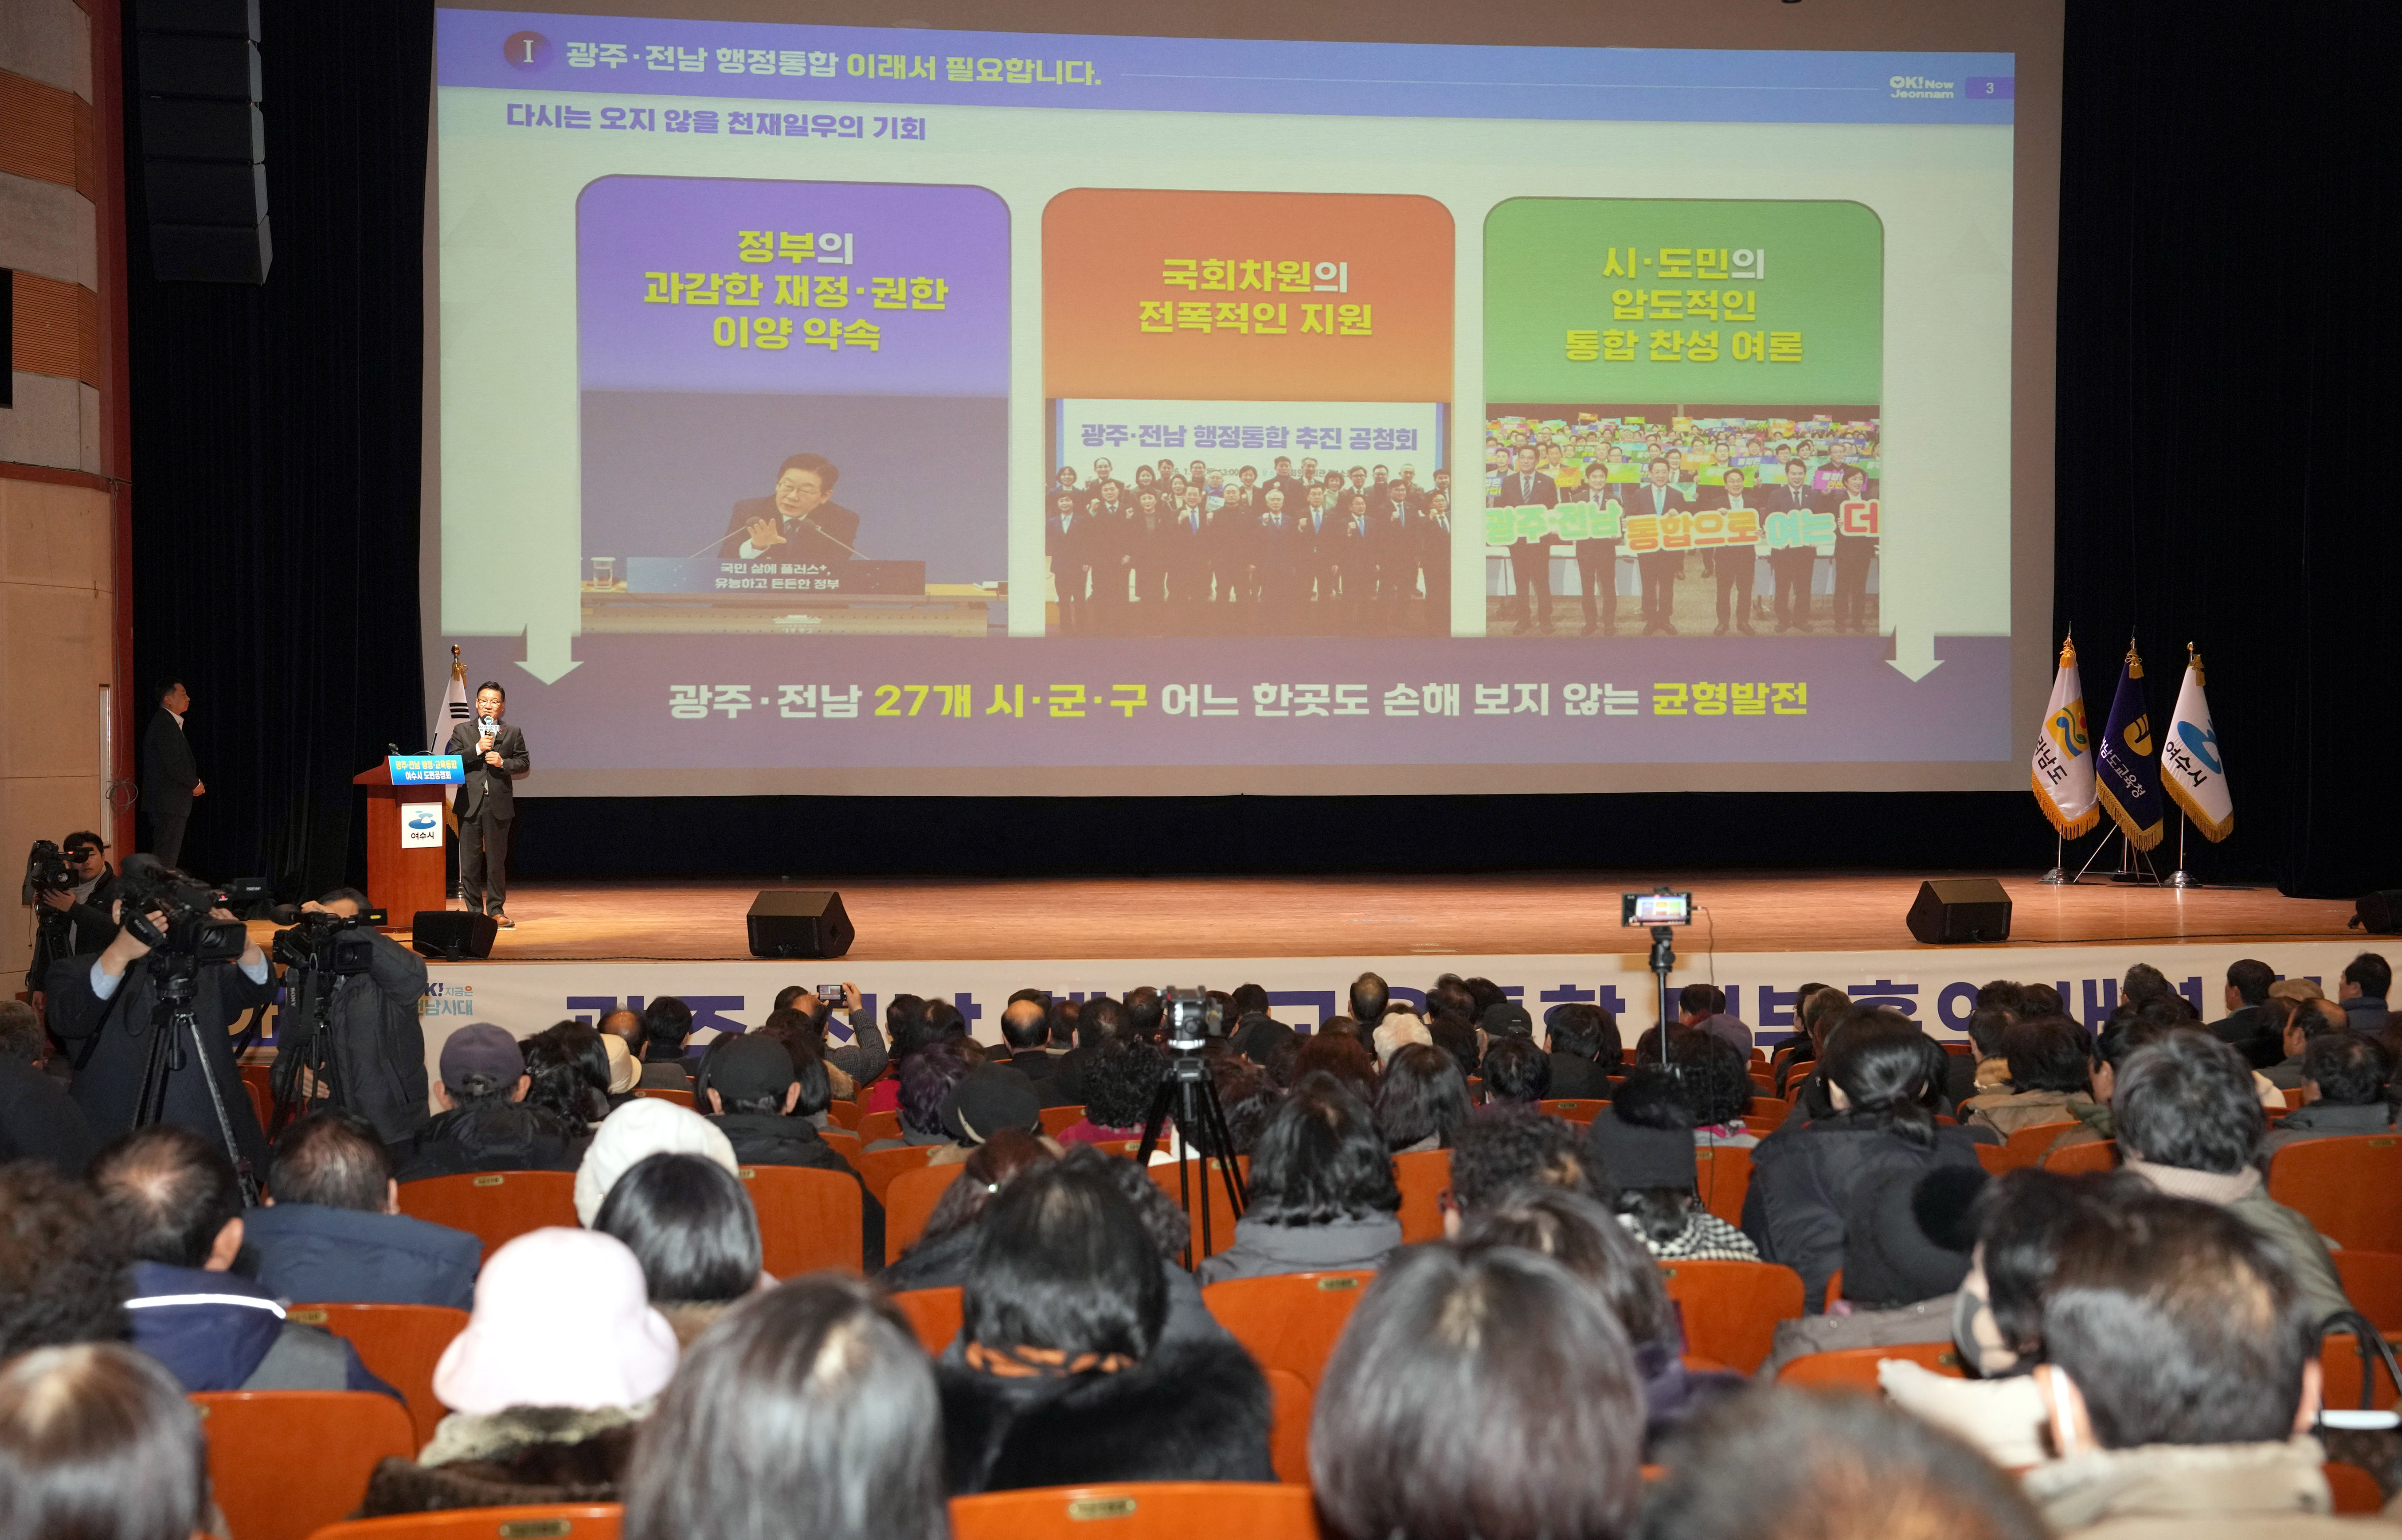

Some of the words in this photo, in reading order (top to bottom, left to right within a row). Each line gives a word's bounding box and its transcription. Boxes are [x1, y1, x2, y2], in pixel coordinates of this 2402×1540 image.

[567, 42, 708, 72] 광주·전남
[716, 47, 840, 78] 행정통합
[847, 53, 936, 81] 이래서
[946, 56, 1102, 86] 필요합니다.
[1890, 75, 1924, 89] OK!
[1890, 89, 1955, 99] Jeonnam
[1986, 82, 1995, 94] 3
[507, 103, 591, 129] 다시는
[600, 107, 655, 132] 오지
[664, 109, 719, 134] 않을
[727, 111, 864, 139] 천재일우의
[872, 116, 926, 140] 기회
[738, 231, 854, 265] 정부의
[1602, 247, 1765, 280] 시·도민의
[643, 271, 764, 306] 과감한
[774, 275, 950, 310] 재정·권한
[1162, 258, 1348, 293] 국회차원의
[1138, 301, 1287, 334] 전폭적인
[1300, 303, 1373, 335] 지원
[1612, 289, 1756, 321] 압도적인
[712, 316, 794, 350] 이양
[803, 317, 881, 352] 약속
[1565, 328, 1639, 362] 통합
[1649, 328, 1720, 362] 찬성
[1732, 330, 1803, 362] 여론
[1081, 424, 1188, 448] 광주·전남
[1193, 425, 1291, 449] 행정통합
[1295, 427, 1342, 450] 추진
[1348, 427, 1418, 451] 공청회
[1486, 501, 1619, 543] 광주·전남
[1627, 511, 1760, 551] 통합으로
[1767, 511, 1834, 546] 여는
[1843, 501, 1878, 534] 더
[715, 578, 768, 589] 유능하고
[771, 578, 811, 590] 든든한
[814, 578, 840, 590] 정부
[720, 563, 747, 574] 국민
[751, 563, 777, 574] 삶에
[669, 684, 863, 719] 광주·전남
[874, 684, 971, 718] 27개
[985, 684, 1147, 718] 시·군·구
[1162, 684, 1239, 717] 어느
[1253, 682, 1370, 717] 한곳도
[1383, 683, 1460, 716] 손해
[1474, 683, 1549, 716] 보지
[1563, 683, 1639, 716] 않는
[1652, 681, 1807, 715] 균형발전
[395, 760, 421, 770] 광주·전남
[405, 770, 423, 780] 여수시
[423, 770, 452, 780] 도민공청회
[2166, 741, 2208, 788] 여수시
[411, 831, 434, 840] 여수시
[445, 985, 473, 997] 지금은
